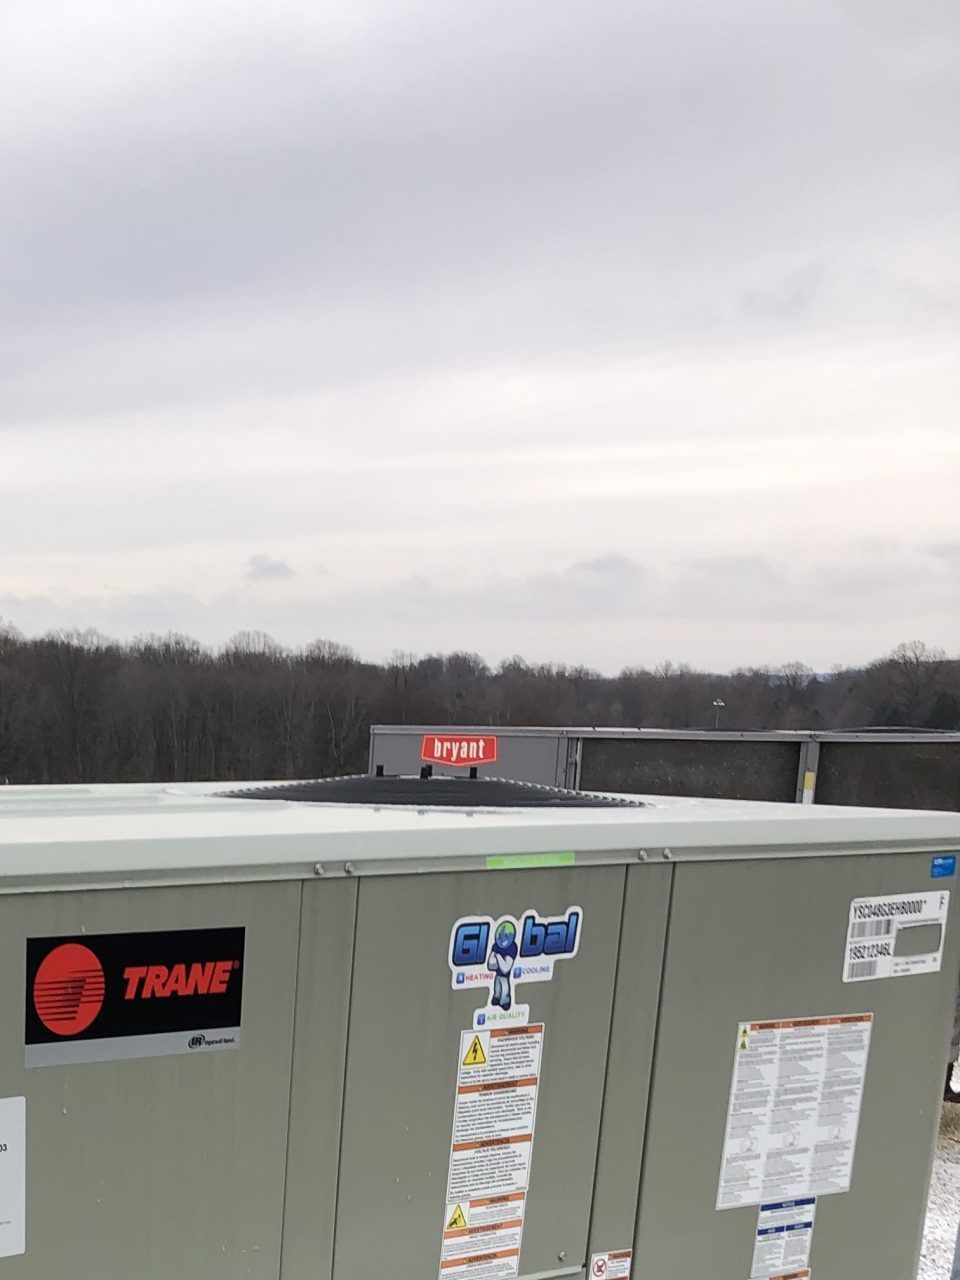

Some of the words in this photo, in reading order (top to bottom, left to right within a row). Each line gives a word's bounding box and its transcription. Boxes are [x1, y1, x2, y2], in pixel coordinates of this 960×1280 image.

[434, 738, 485, 761] bryant
[522, 966, 550, 975] COOLING
[465, 973, 493, 981] HEATING
[499, 1012, 525, 1020] QUALITY
